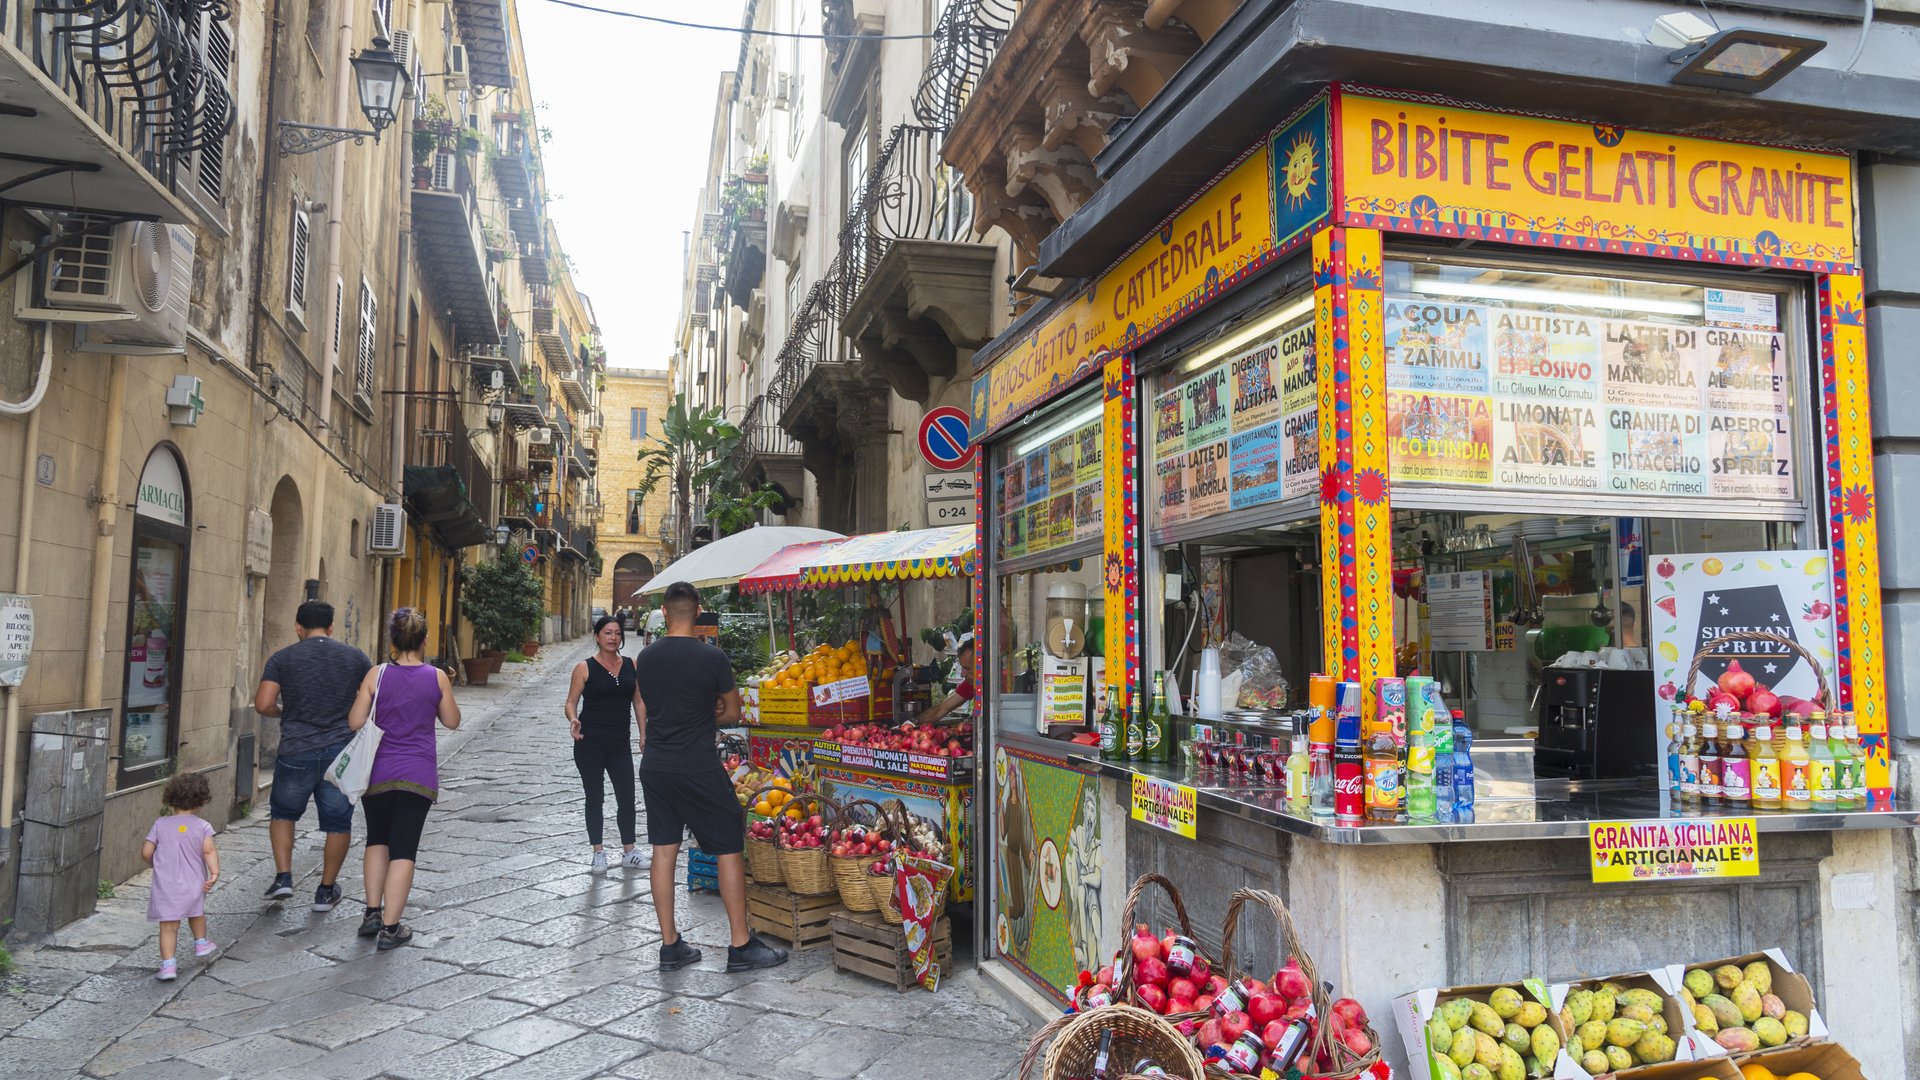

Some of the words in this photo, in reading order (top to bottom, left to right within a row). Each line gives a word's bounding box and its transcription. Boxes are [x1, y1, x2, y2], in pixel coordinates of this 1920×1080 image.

[1371, 111, 1511, 190] BIBITE
[1523, 140, 1676, 209] GELATI
[1688, 160, 1845, 228] GRANITE
[991, 322, 1078, 407] CHIOSCHETTO
[1084, 321, 1106, 345] DELLA
[1113, 192, 1242, 321] CATTEDRALE
[1385, 303, 1482, 326] ACQUA
[1497, 313, 1591, 337] AUTISTA
[1606, 323, 1668, 350] LATTE
[1676, 329, 1697, 349] DI
[1706, 329, 1781, 351] GRANITA
[1232, 344, 1278, 377] DIGESTIVO
[1286, 357, 1299, 374] Alla
[1403, 347, 1482, 370] ZAMMU
[1498, 356, 1592, 380] ESPLOSIVO
[1187, 369, 1226, 400] GRANITA
[1284, 367, 1317, 395] MANDO
[1607, 364, 1697, 389] MANDORLA
[1708, 370, 1727, 389] AL
[1733, 374, 1783, 392] CAFFE'
[1233, 384, 1278, 415] AUTISTA
[1386, 392, 1489, 419] GRANITA
[1204, 404, 1227, 427] MENTA
[1499, 402, 1596, 428] LIMONATA
[1609, 409, 1681, 433] GRANITA
[1685, 415, 1700, 435] DI
[1710, 416, 1787, 434] APEROL
[1076, 421, 1102, 445] LIMONATA
[1156, 420, 1184, 446] ARANCE
[1232, 424, 1278, 453] MULTIVITAMINICO
[1189, 445, 1214, 469] LATTE
[1216, 440, 1227, 460] DI
[1251, 442, 1278, 455] MELOGRANO
[1427, 438, 1490, 461] D'INDIA
[1502, 445, 1529, 464] AL
[1541, 448, 1596, 468] SALE
[1157, 458, 1175, 476] CREMA
[1177, 455, 1186, 470] AL
[1285, 451, 1319, 477] MELOGR
[1612, 451, 1700, 474] PISTACCHIO
[1712, 457, 1789, 476] SPRITZ
[1190, 476, 1228, 501] MANDORLA
[1501, 471, 1513, 483] Cu
[1515, 471, 1548, 485] Mancia
[1612, 476, 1627, 489] Cu
[1630, 477, 1657, 491] Nesci
[1659, 478, 1702, 493] Arrinesci
[1159, 488, 1187, 509] CAFFE'
[938, 506, 967, 518] 0-24
[1054, 693, 1083, 702] ANGURIA
[1341, 704, 1355, 712] Bull
[814, 741, 841, 751] AUTISTA
[842, 745, 867, 756] SPREMUTA
[867, 748, 874, 757] DI
[873, 749, 908, 762] LIMONATA
[842, 755, 874, 767] MELAGRANA
[875, 760, 885, 769] AL
[887, 761, 908, 772] SALE
[909, 754, 947, 767] MULTIVITAMINICO
[910, 762, 945, 772] NATURALE
[1133, 778, 1160, 801] GRANITA
[1161, 786, 1195, 812] SICILIANA
[1138, 797, 1188, 825] ARTIGIANALE
[1594, 825, 1670, 850] GRANITA
[1674, 822, 1753, 847] SICILIANA
[1610, 847, 1741, 866] ARTIGIANALE
